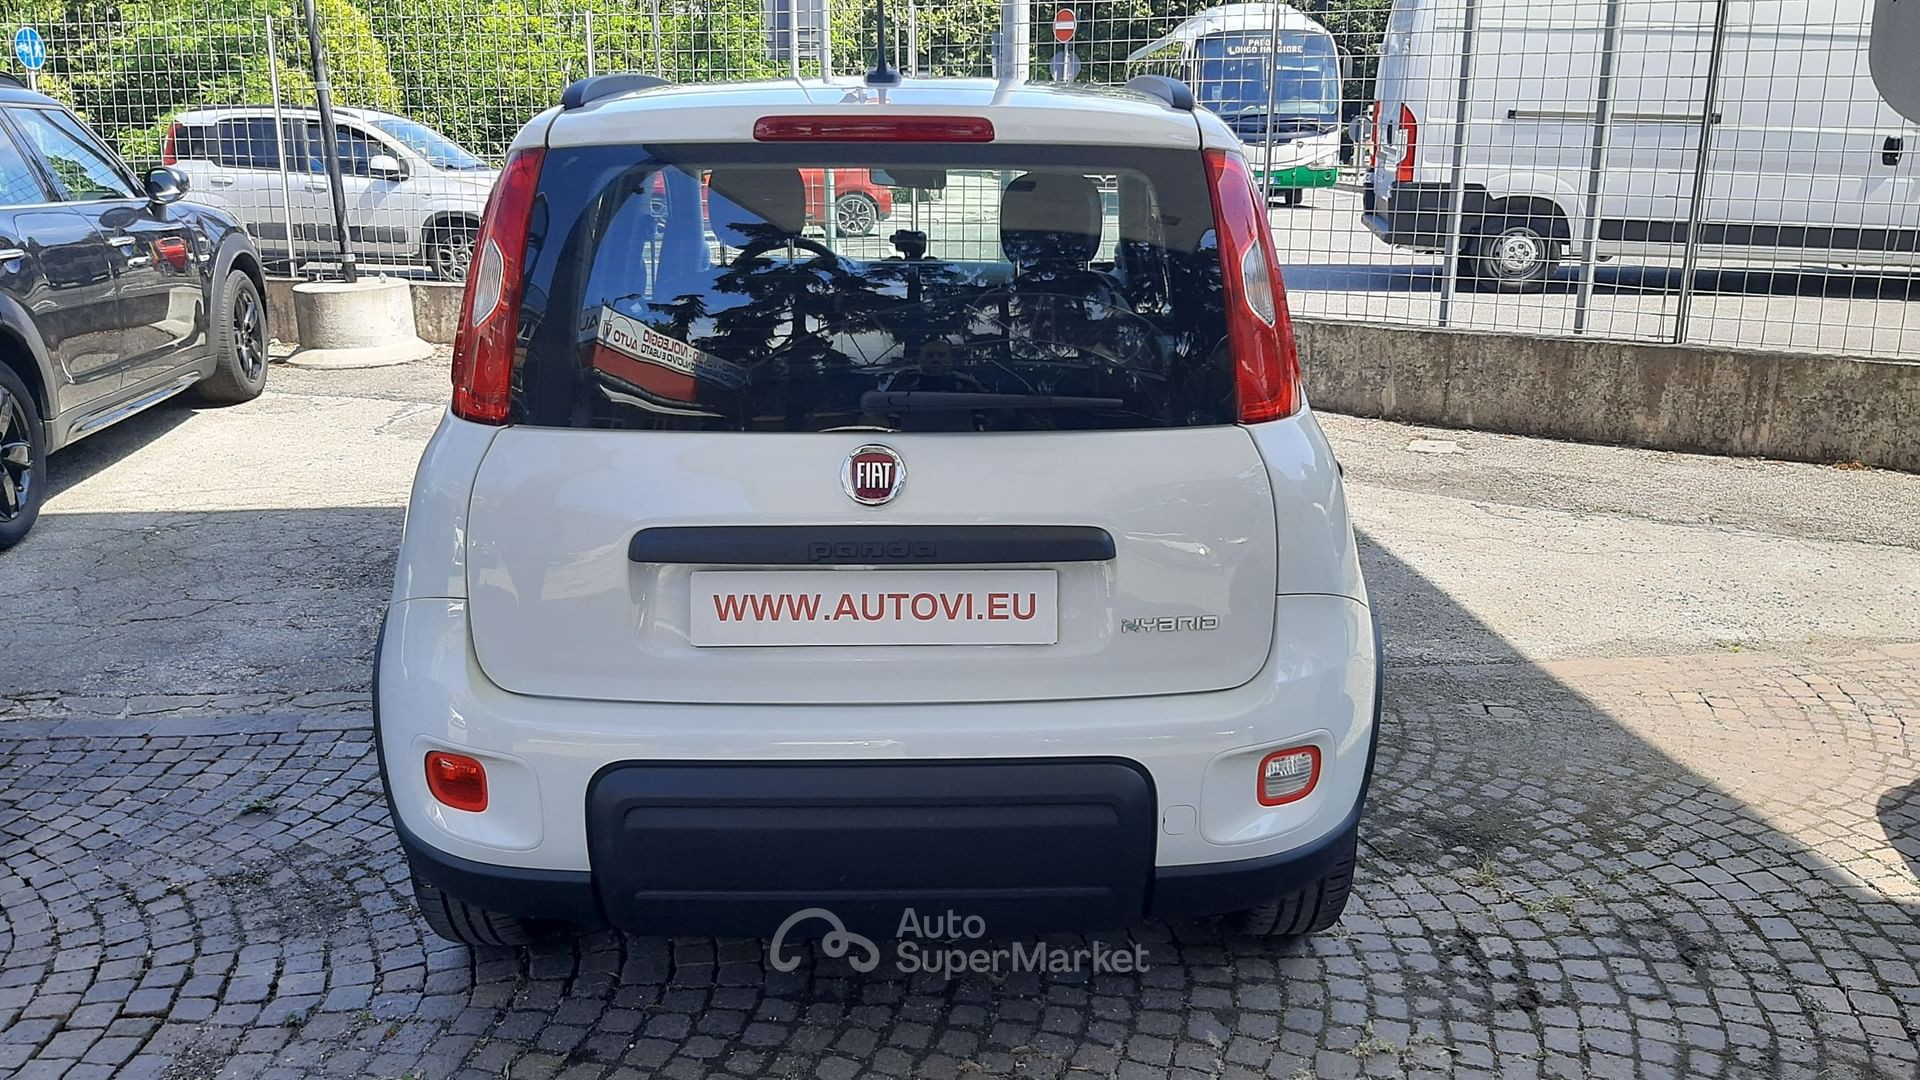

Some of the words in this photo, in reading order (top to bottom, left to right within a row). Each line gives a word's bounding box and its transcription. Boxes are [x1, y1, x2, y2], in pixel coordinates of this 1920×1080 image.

[1248, 39, 1283, 47] PADOA
[1259, 45, 1304, 54] MAGIORE
[856, 460, 894, 489] FIAT
[808, 539, 937, 562] panda
[712, 592, 1037, 621] WWW.AUTOVI.EU
